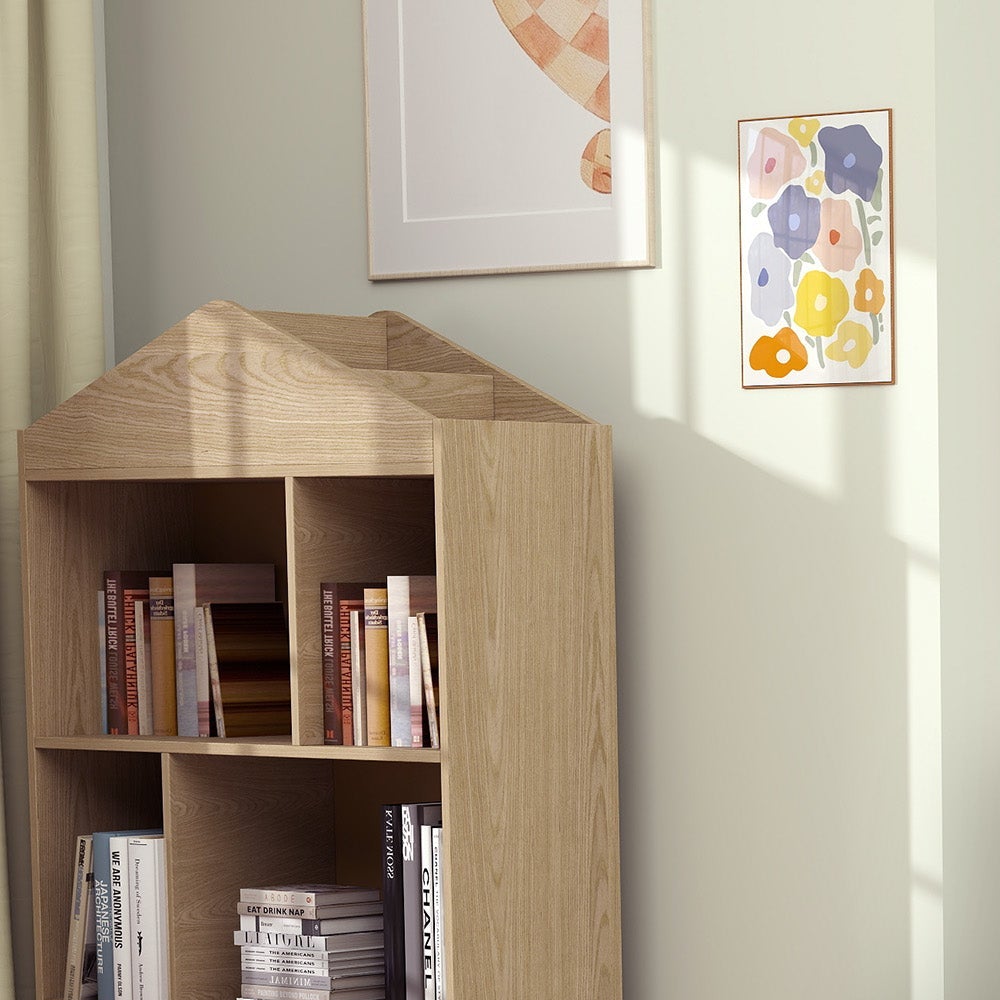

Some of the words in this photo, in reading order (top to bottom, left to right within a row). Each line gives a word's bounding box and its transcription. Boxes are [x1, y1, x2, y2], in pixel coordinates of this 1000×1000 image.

[111, 851, 120, 866] WE
[112, 867, 121, 887] ARE
[94, 879, 104, 974] ARCHITECTURE
[100, 879, 110, 943] JAPANESE
[112, 888, 123, 949] ANONYMOUS
[247, 905, 261, 914] EAT
[263, 906, 287, 916] DRINK
[289, 908, 305, 917] NAP
[422, 868, 433, 989] CHANEL
